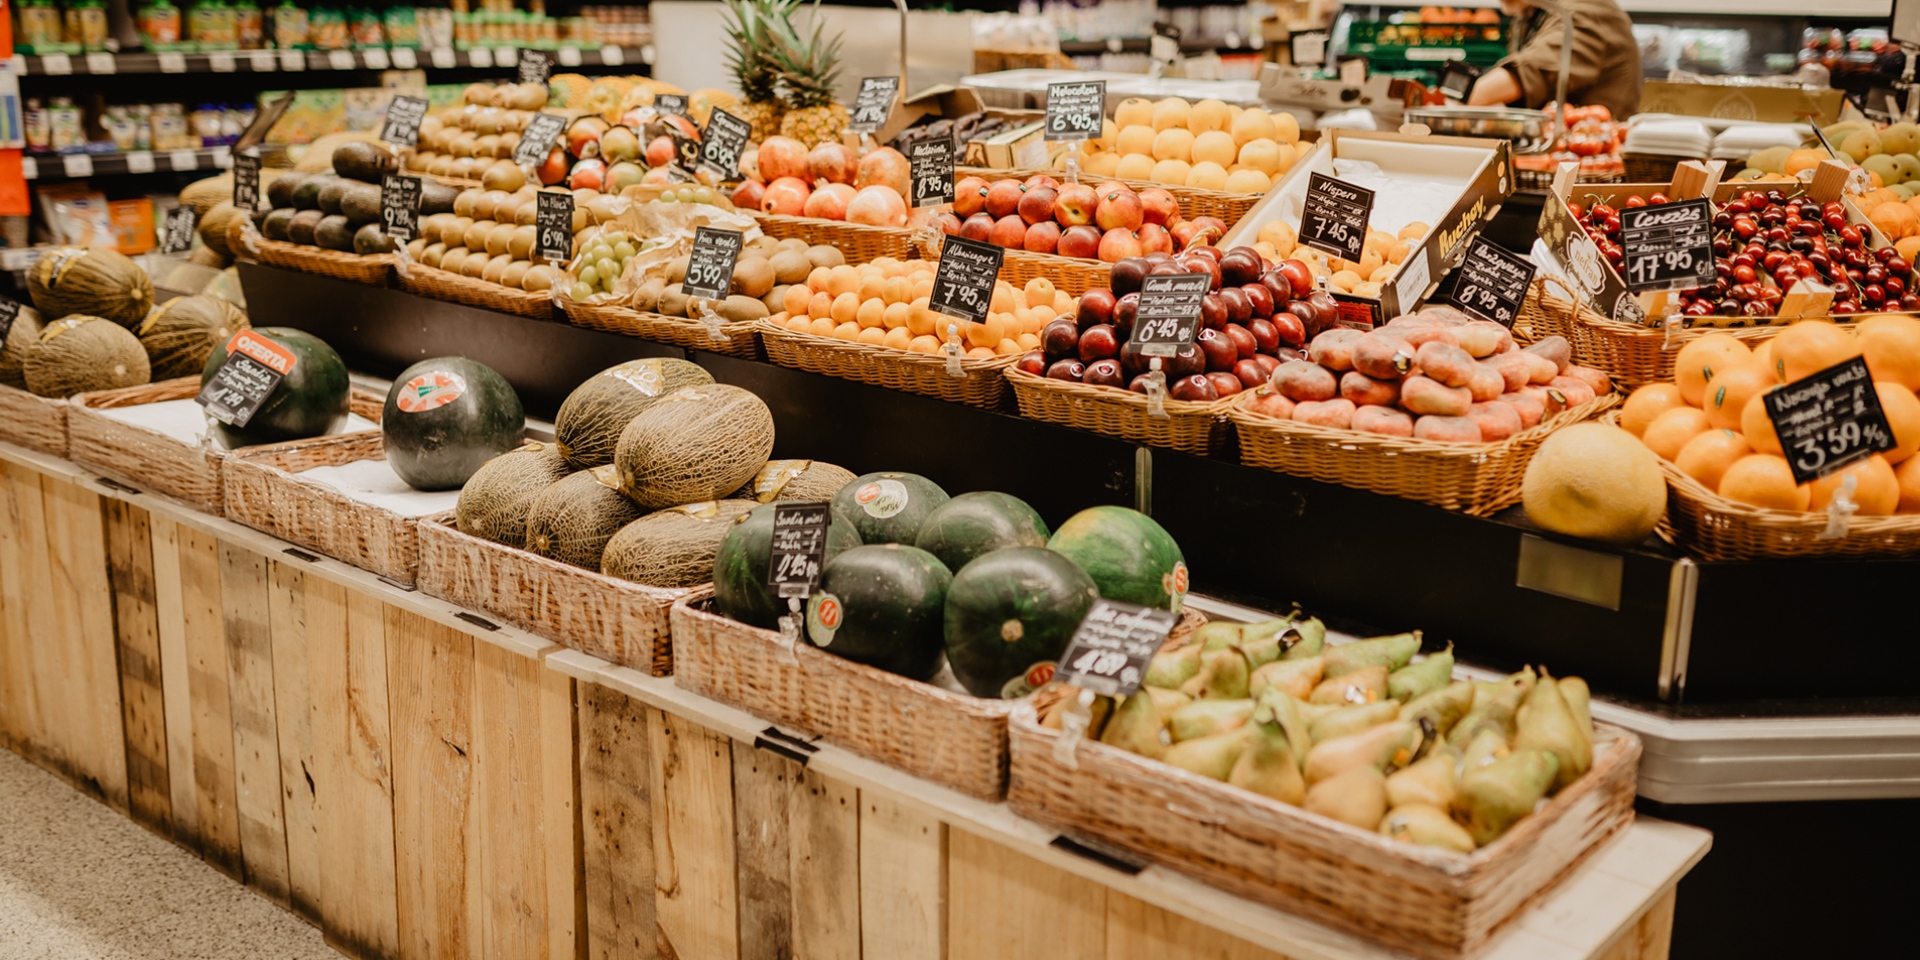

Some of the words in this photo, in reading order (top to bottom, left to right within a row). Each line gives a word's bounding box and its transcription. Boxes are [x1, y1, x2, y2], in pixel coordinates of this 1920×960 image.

[1052, 113, 1091, 131] 6'95
[917, 176, 942, 199] 8'95
[1319, 181, 1357, 200] Nispero
[1313, 216, 1348, 242] 7'45
[1633, 207, 1701, 228] Cerezas
[542, 228, 564, 248] 6'99
[687, 264, 722, 285] 5'99
[1629, 249, 1693, 283] 17'95
[944, 282, 978, 306] 7'95
[1459, 285, 1498, 310] 8'95
[1139, 318, 1179, 343] 6'45
[236, 336, 287, 370] OFERTA
[1775, 382, 1830, 412] Naranja
[1793, 421, 1861, 471] 3'59
